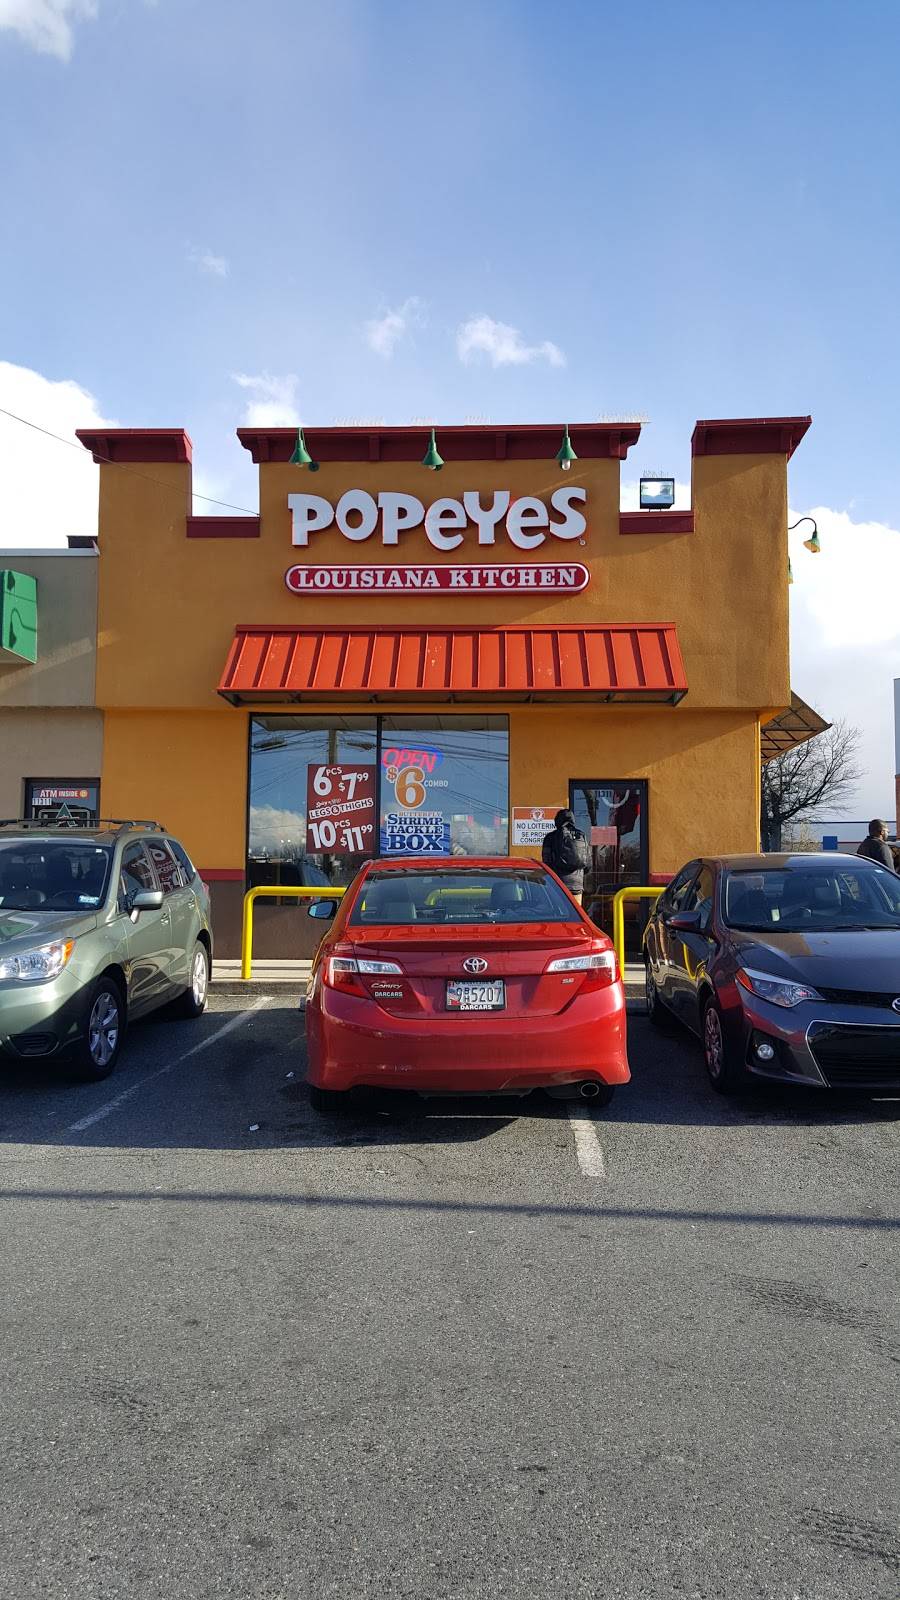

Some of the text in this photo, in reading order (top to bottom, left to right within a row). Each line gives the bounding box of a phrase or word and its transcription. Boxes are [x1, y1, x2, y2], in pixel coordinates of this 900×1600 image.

[298, 568, 578, 588] LOUISIANA KITCHEN
[383, 748, 436, 773] OPEN
[313, 766, 333, 796] 6
[326, 766, 343, 776] PCS
[39, 789, 80, 798] ATM INSIDE
[310, 807, 331, 819] LEGS
[339, 797, 373, 812] THIGHS
[387, 813, 443, 825] SHRIMP
[308, 820, 337, 849] 10
[334, 819, 351, 828] PCS
[387, 825, 443, 834] TACKLE
[387, 834, 443, 851] BOX
